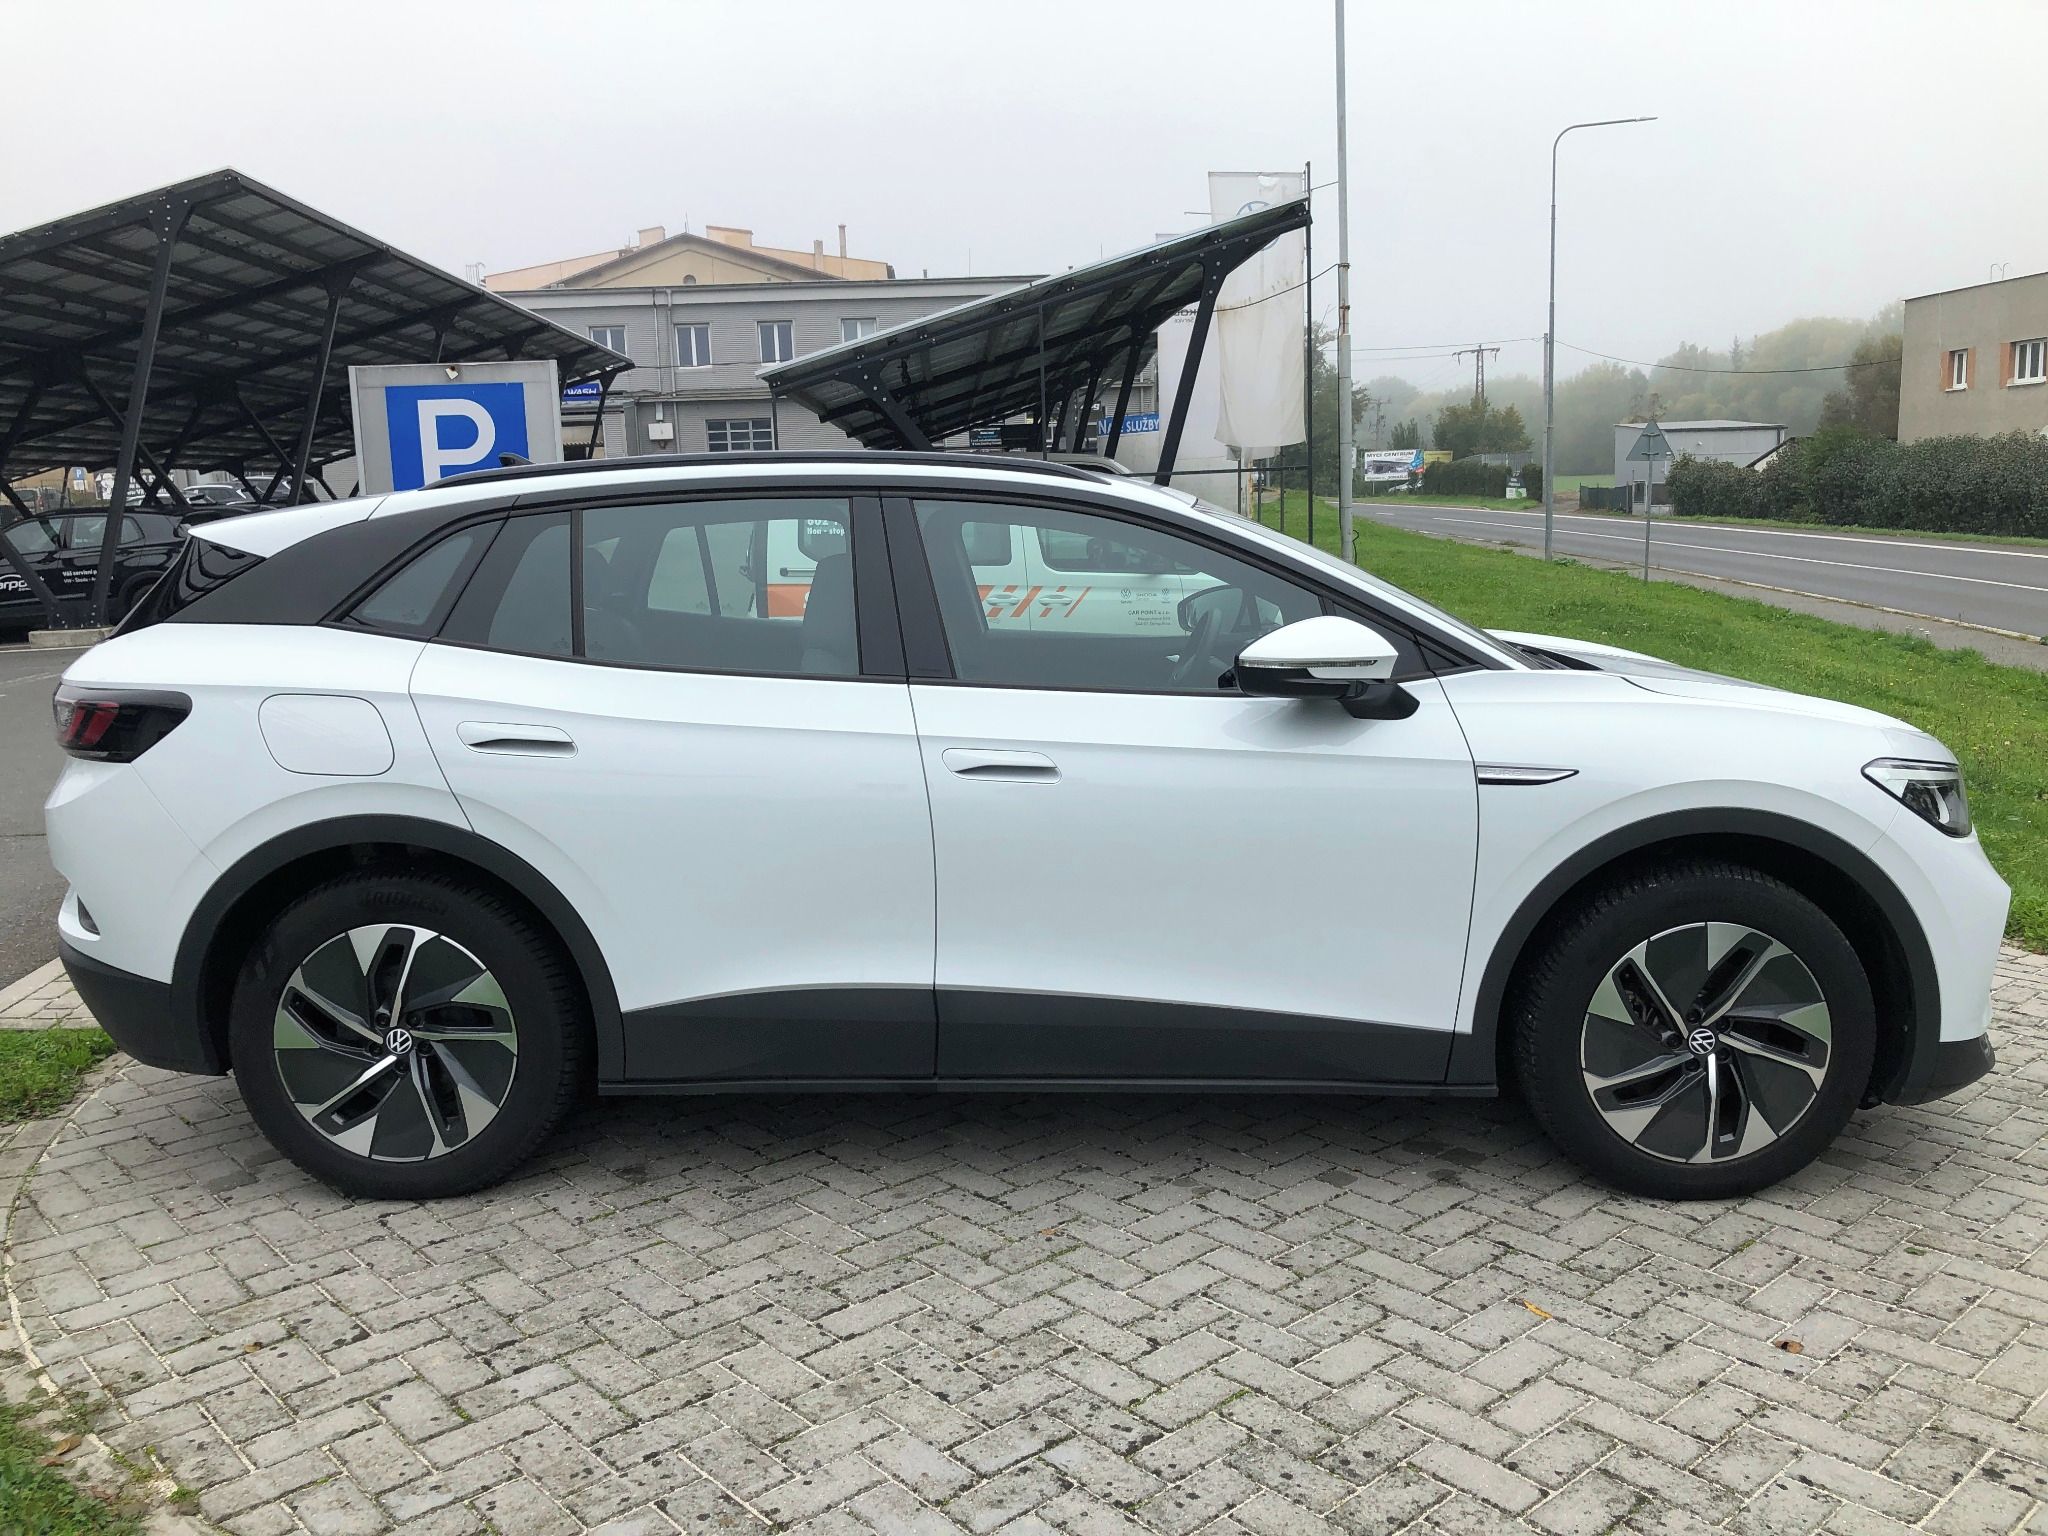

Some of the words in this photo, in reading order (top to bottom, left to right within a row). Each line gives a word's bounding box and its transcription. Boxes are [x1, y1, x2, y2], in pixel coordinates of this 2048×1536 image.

[563, 387, 597, 395] WASH
[1126, 416, 1160, 432] SLUŽBY
[417, 397, 496, 486] P
